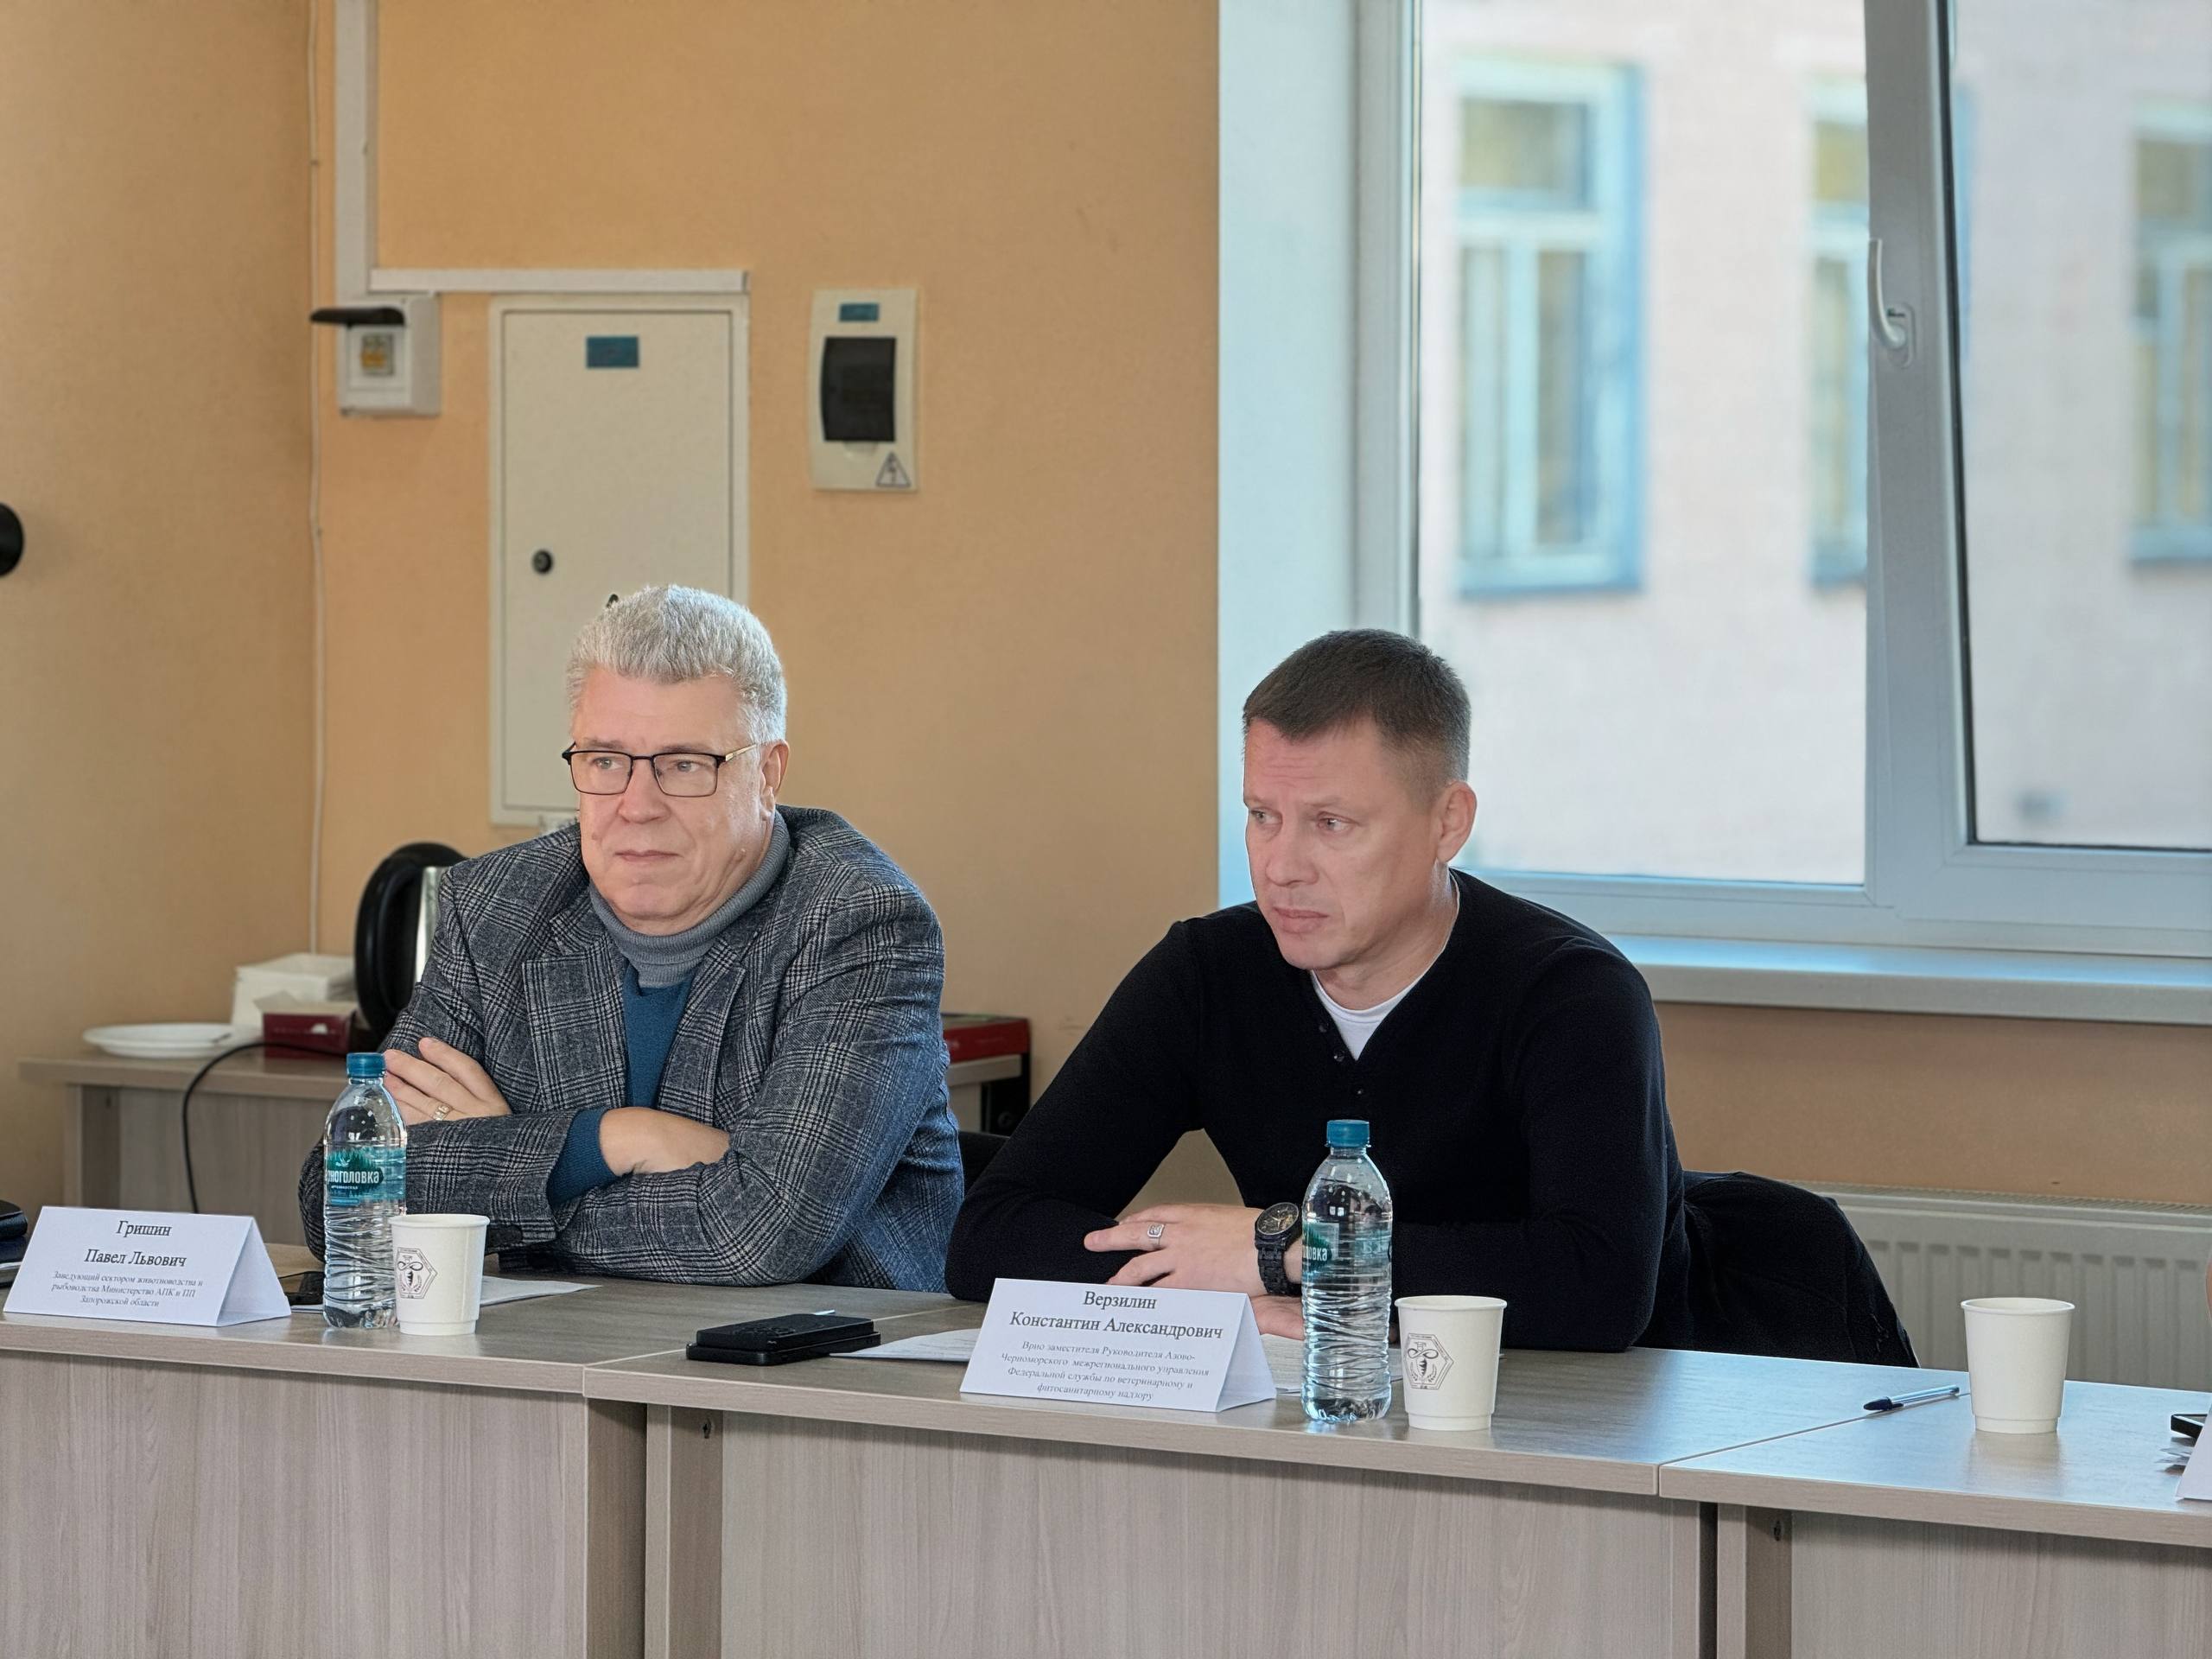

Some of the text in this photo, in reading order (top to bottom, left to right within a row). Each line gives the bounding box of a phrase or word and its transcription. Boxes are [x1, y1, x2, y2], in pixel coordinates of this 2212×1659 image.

[116, 1220, 172, 1237] Гришин
[84, 1249, 187, 1267] Павел Львович
[54, 1271, 101, 1282] Заведующий
[101, 1275, 136, 1285] сектором
[137, 1277, 196, 1287] животноводства
[51, 1282, 100, 1293] рыбоводства
[156, 1287, 175, 1296] АПК
[182, 1289, 196, 1298] ПП
[80, 1294, 159, 1307] Запорожской области
[1083, 1291, 1157, 1310] Верзилин
[1009, 1311, 1224, 1339] Константин Александрович
[1022, 1341, 1196, 1361] Врио заместителя Руководителя Азово-
[1001, 1352, 1210, 1376] Черноморского межрегионального управления
[1007, 1367, 1066, 1379] Федеральной
[1067, 1372, 1102, 1382] службы
[1103, 1375, 1116, 1383] по
[1117, 1377, 1184, 1389] ветеринарному
[1037, 1382, 1154, 1402] фитосанитарному надзору
